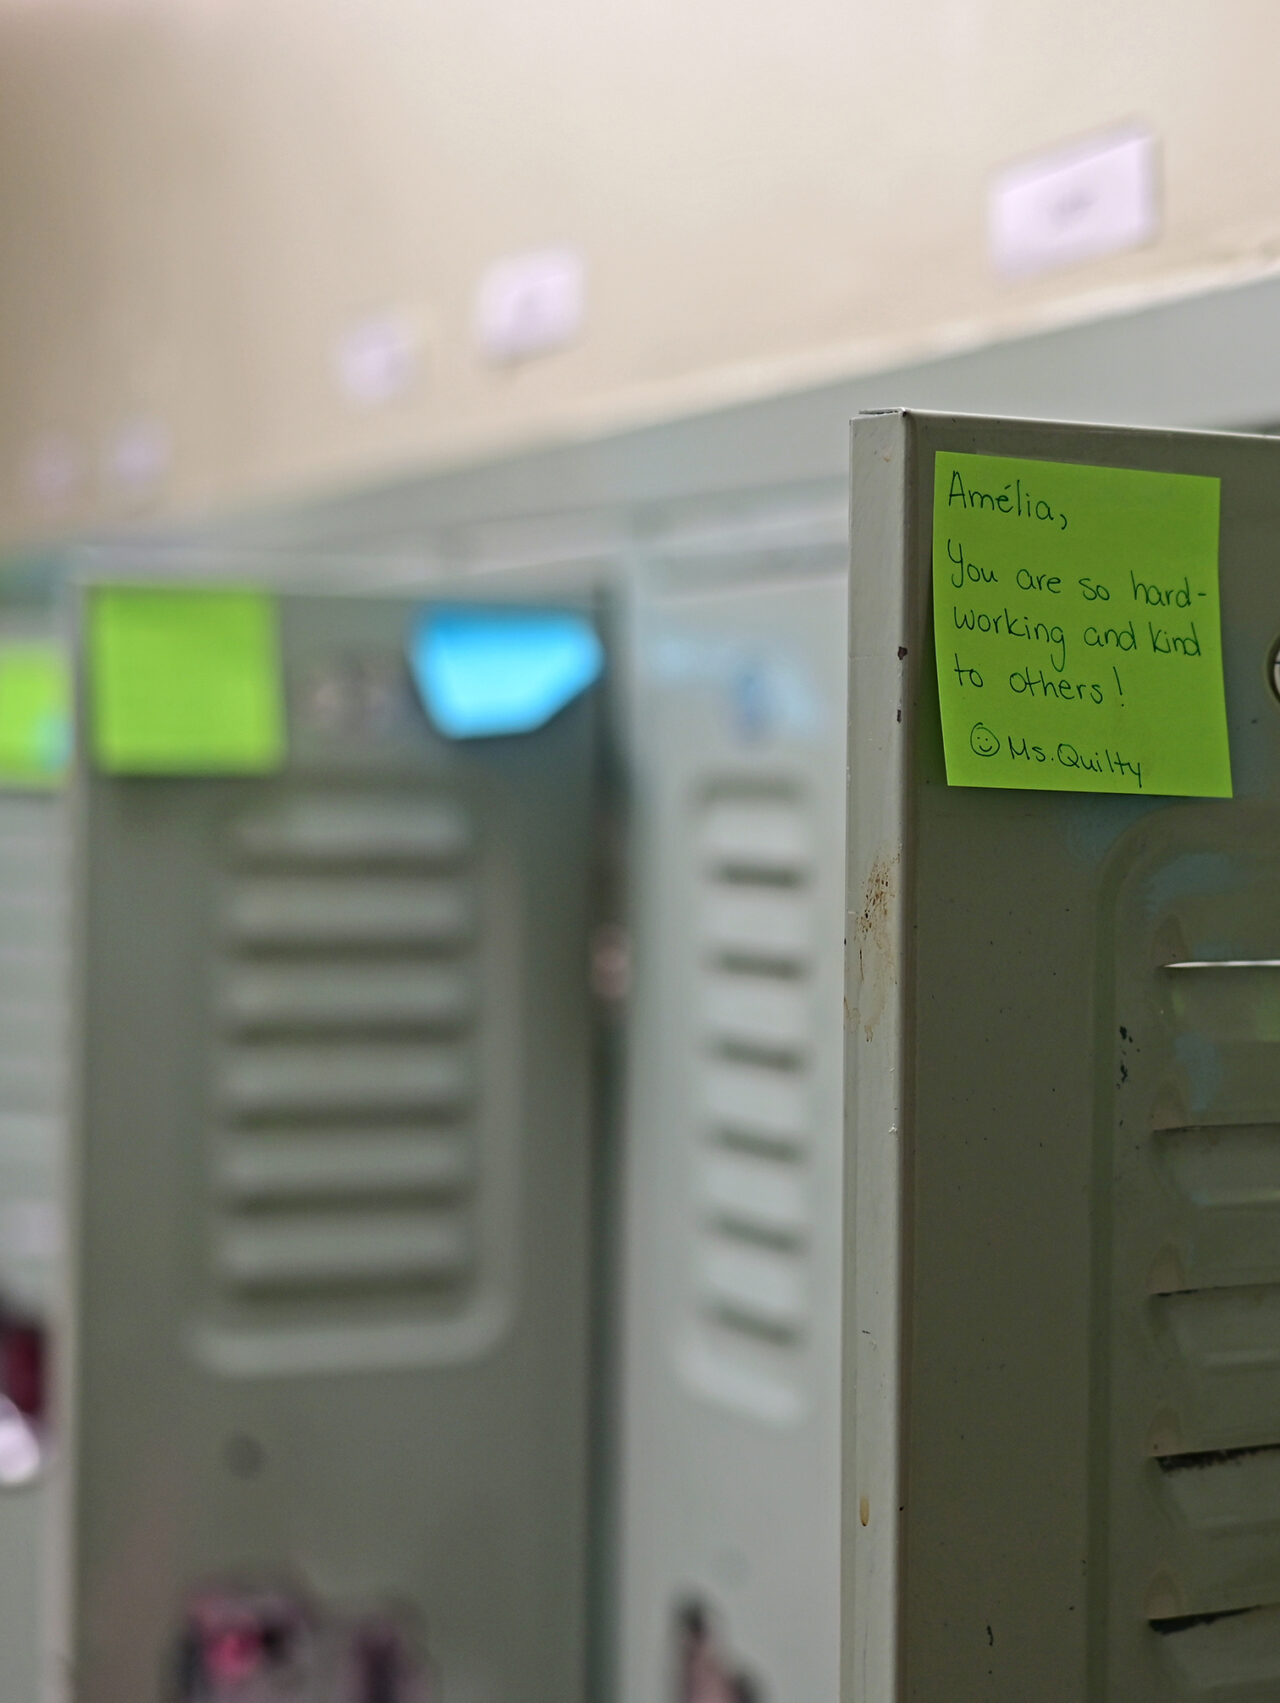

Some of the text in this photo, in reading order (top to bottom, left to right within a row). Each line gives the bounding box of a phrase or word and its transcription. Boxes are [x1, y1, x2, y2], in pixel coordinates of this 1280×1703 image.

[947, 538, 1207, 608] You are so hard-
[953, 605, 1202, 673] working and kind
[953, 652, 984, 687] to
